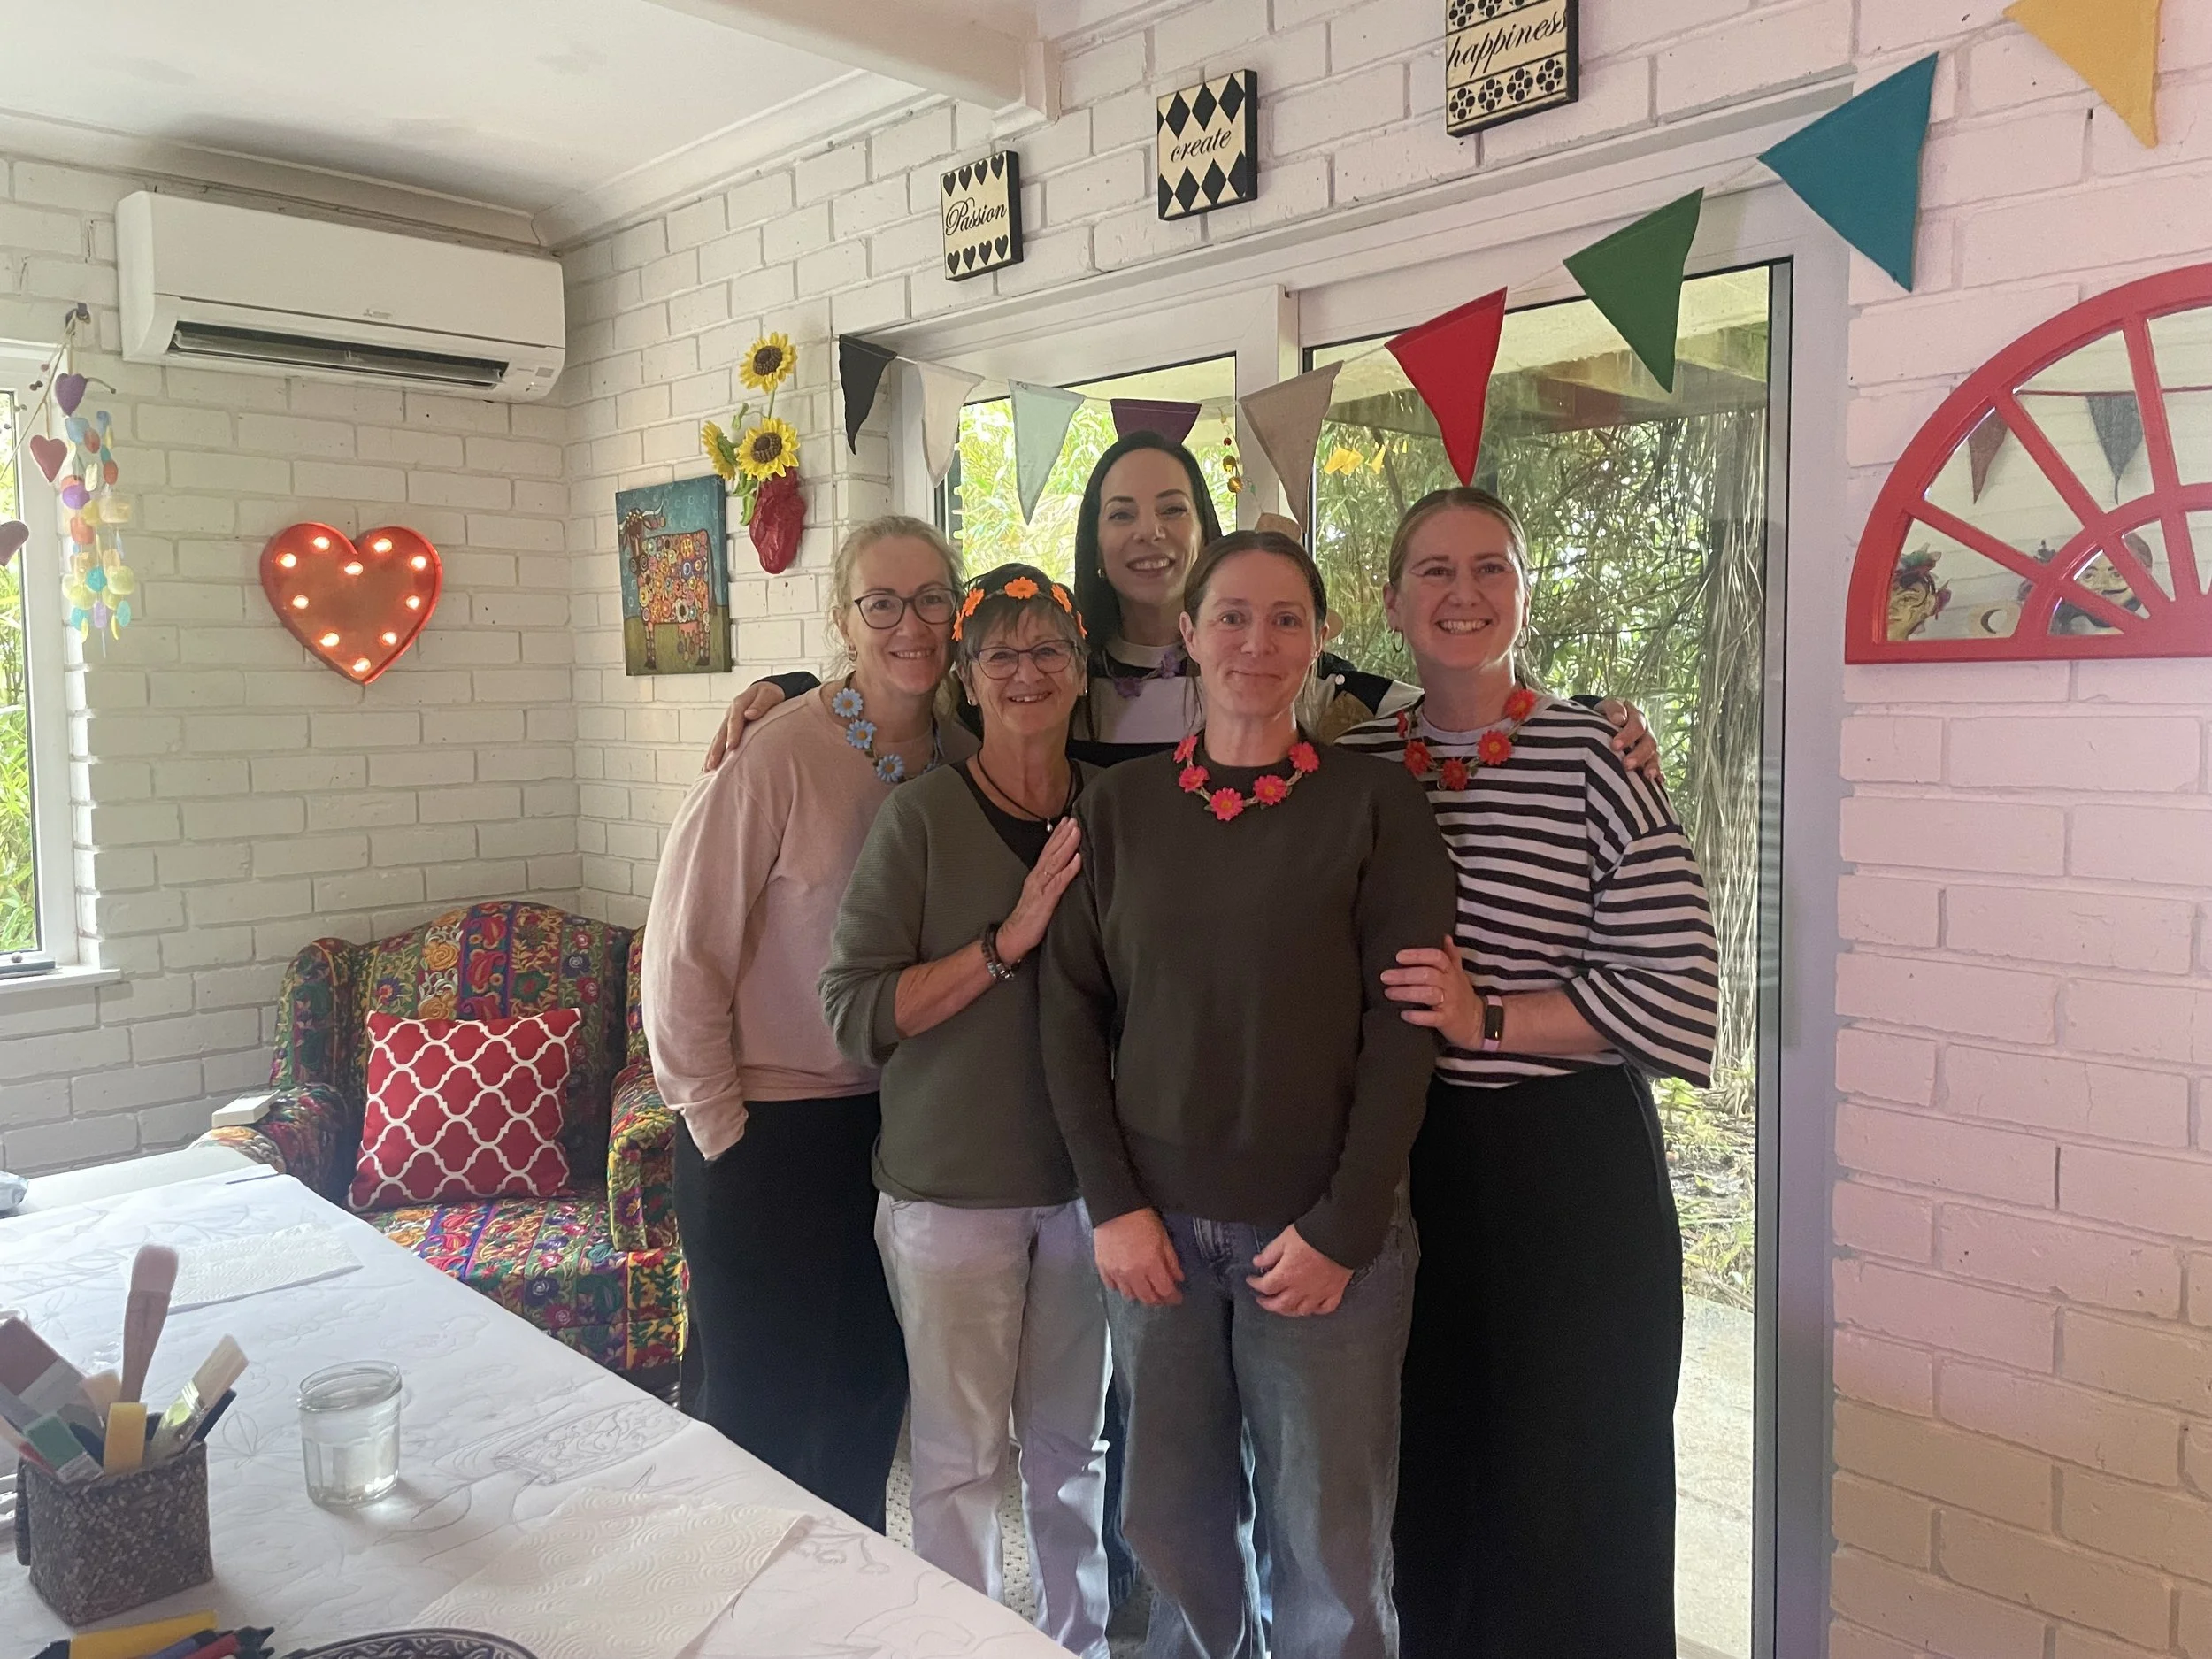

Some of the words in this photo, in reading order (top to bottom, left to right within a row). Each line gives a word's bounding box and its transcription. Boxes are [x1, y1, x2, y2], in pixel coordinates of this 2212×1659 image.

[1447, 9, 1567, 78] happiness
[1171, 128, 1232, 163] create
[945, 196, 1008, 236] Passion
